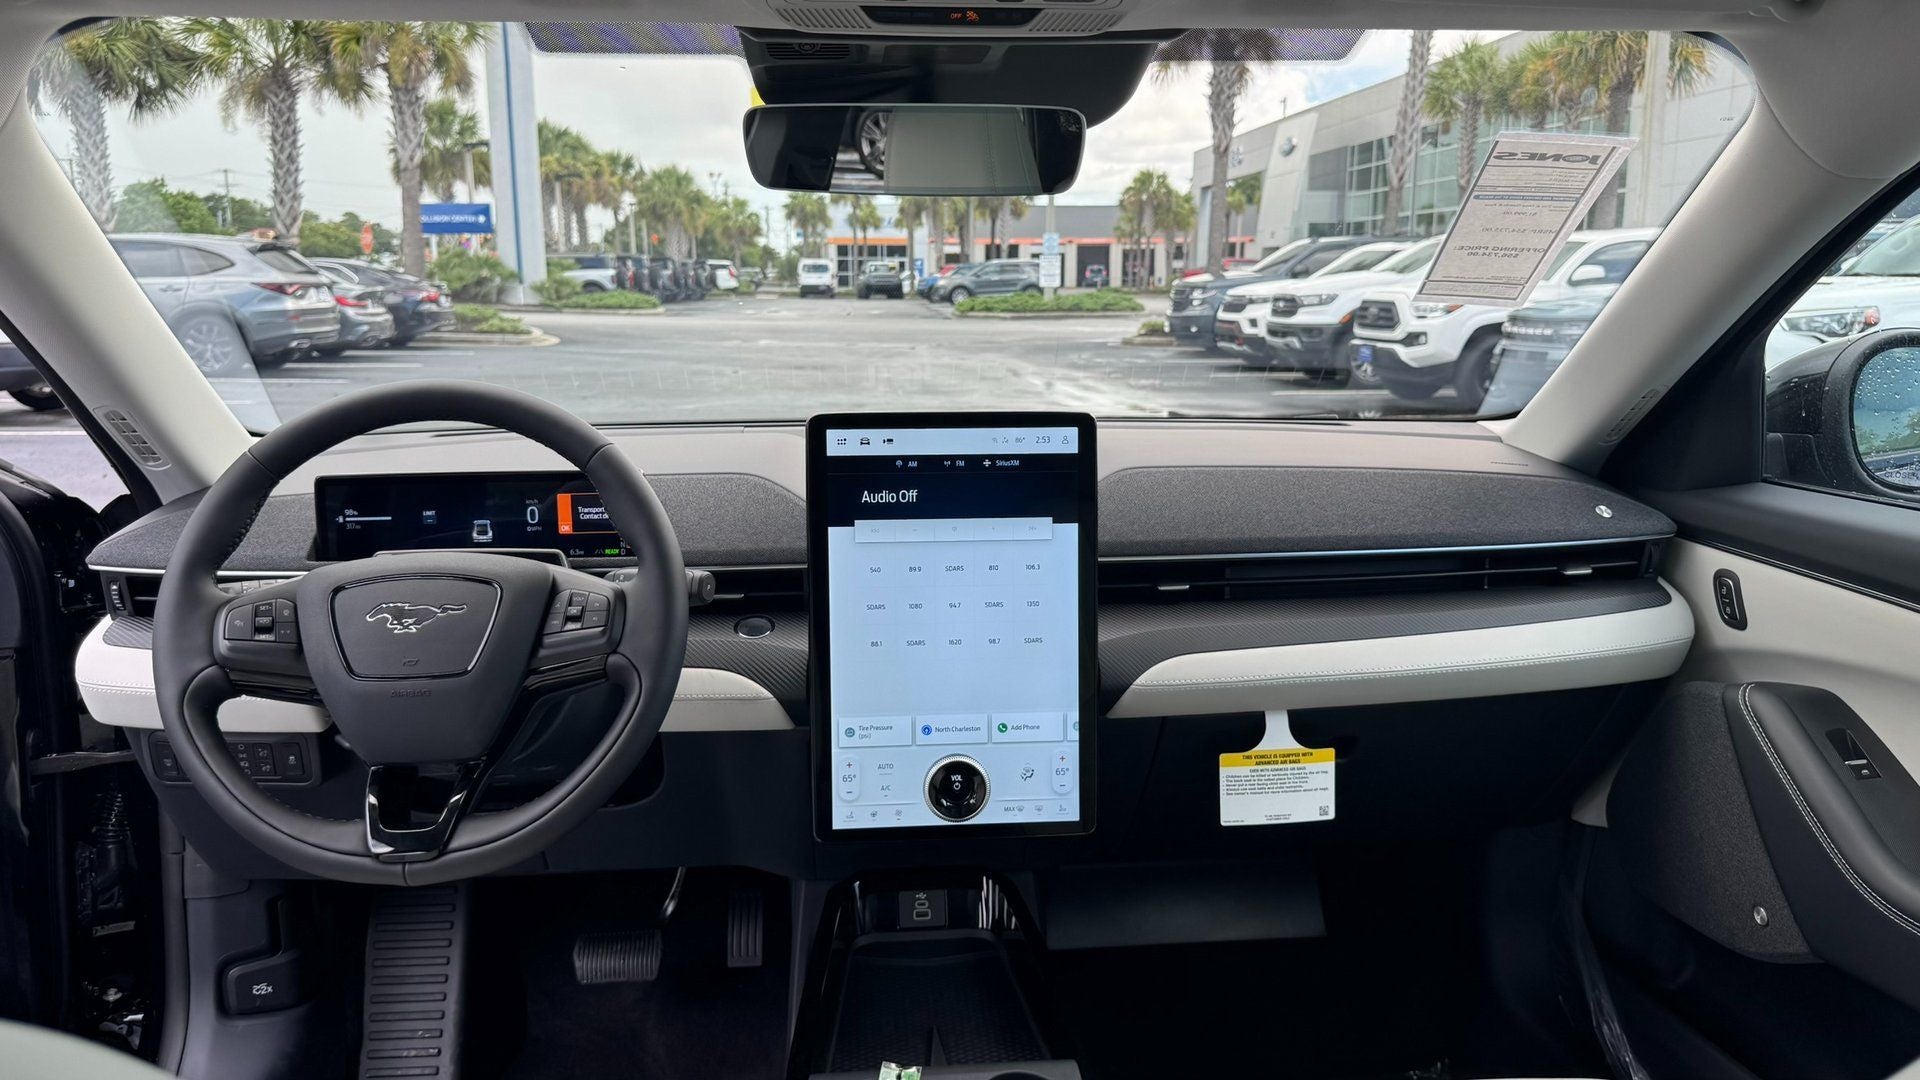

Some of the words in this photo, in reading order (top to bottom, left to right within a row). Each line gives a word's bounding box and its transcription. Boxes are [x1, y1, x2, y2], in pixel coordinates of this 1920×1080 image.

[420, 214, 449, 223] OLLISION
[452, 214, 476, 223] CENTER
[1036, 436, 1050, 444] 2:53
[907, 460, 918, 468] AM
[996, 459, 1020, 467] SiriusXM
[862, 490, 897, 503] Audio
[899, 489, 918, 503] Off
[578, 506, 605, 514] Transport
[526, 506, 539, 524] 0
[866, 603, 886, 611] SDARS
[391, 688, 432, 697] AIRBAG
